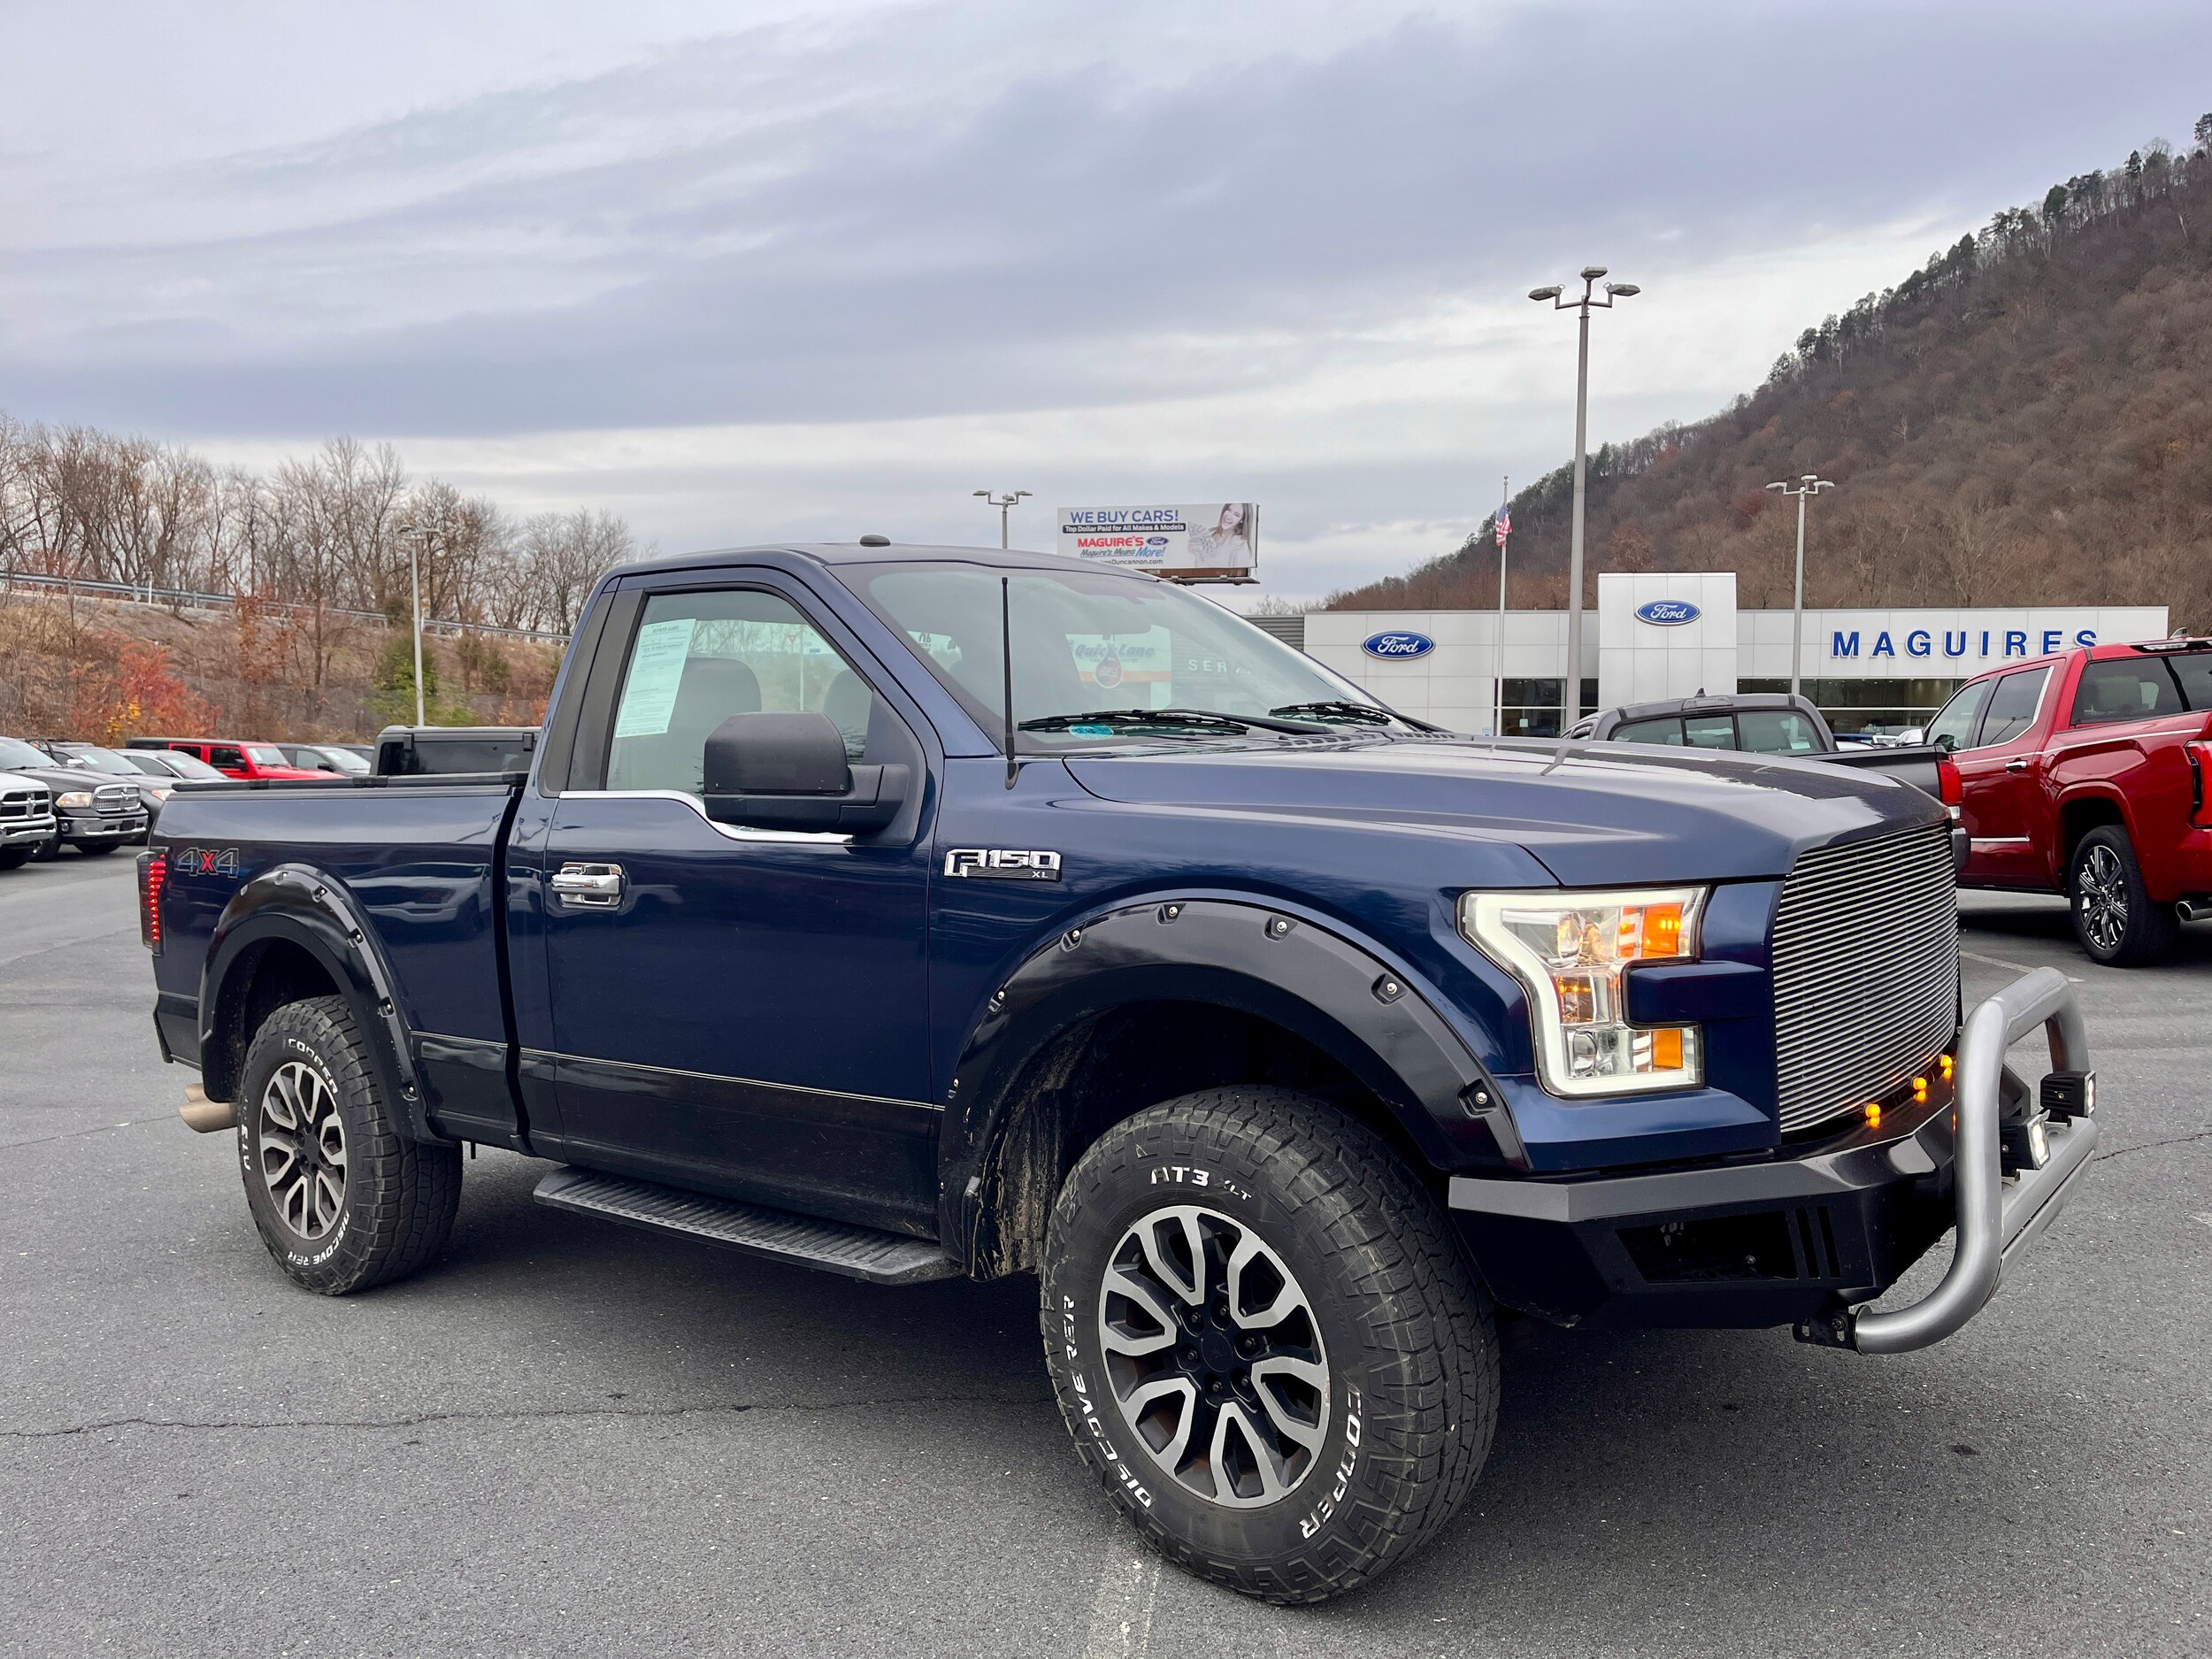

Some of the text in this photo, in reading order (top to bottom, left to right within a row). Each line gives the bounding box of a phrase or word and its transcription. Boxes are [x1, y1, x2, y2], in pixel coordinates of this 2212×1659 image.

[1070, 510, 1179, 523] WE BUY CARS!
[1078, 536, 1144, 548] MAGUIRE'S
[1080, 546, 1166, 558] Maguire's Means More!
[1650, 604, 1686, 621] Ford
[1376, 635, 1419, 655] Ford
[1832, 630, 2097, 657] MAGUIRES
[288, 1038, 338, 1094] COOPER
[1150, 1166, 1210, 1187] AT3
